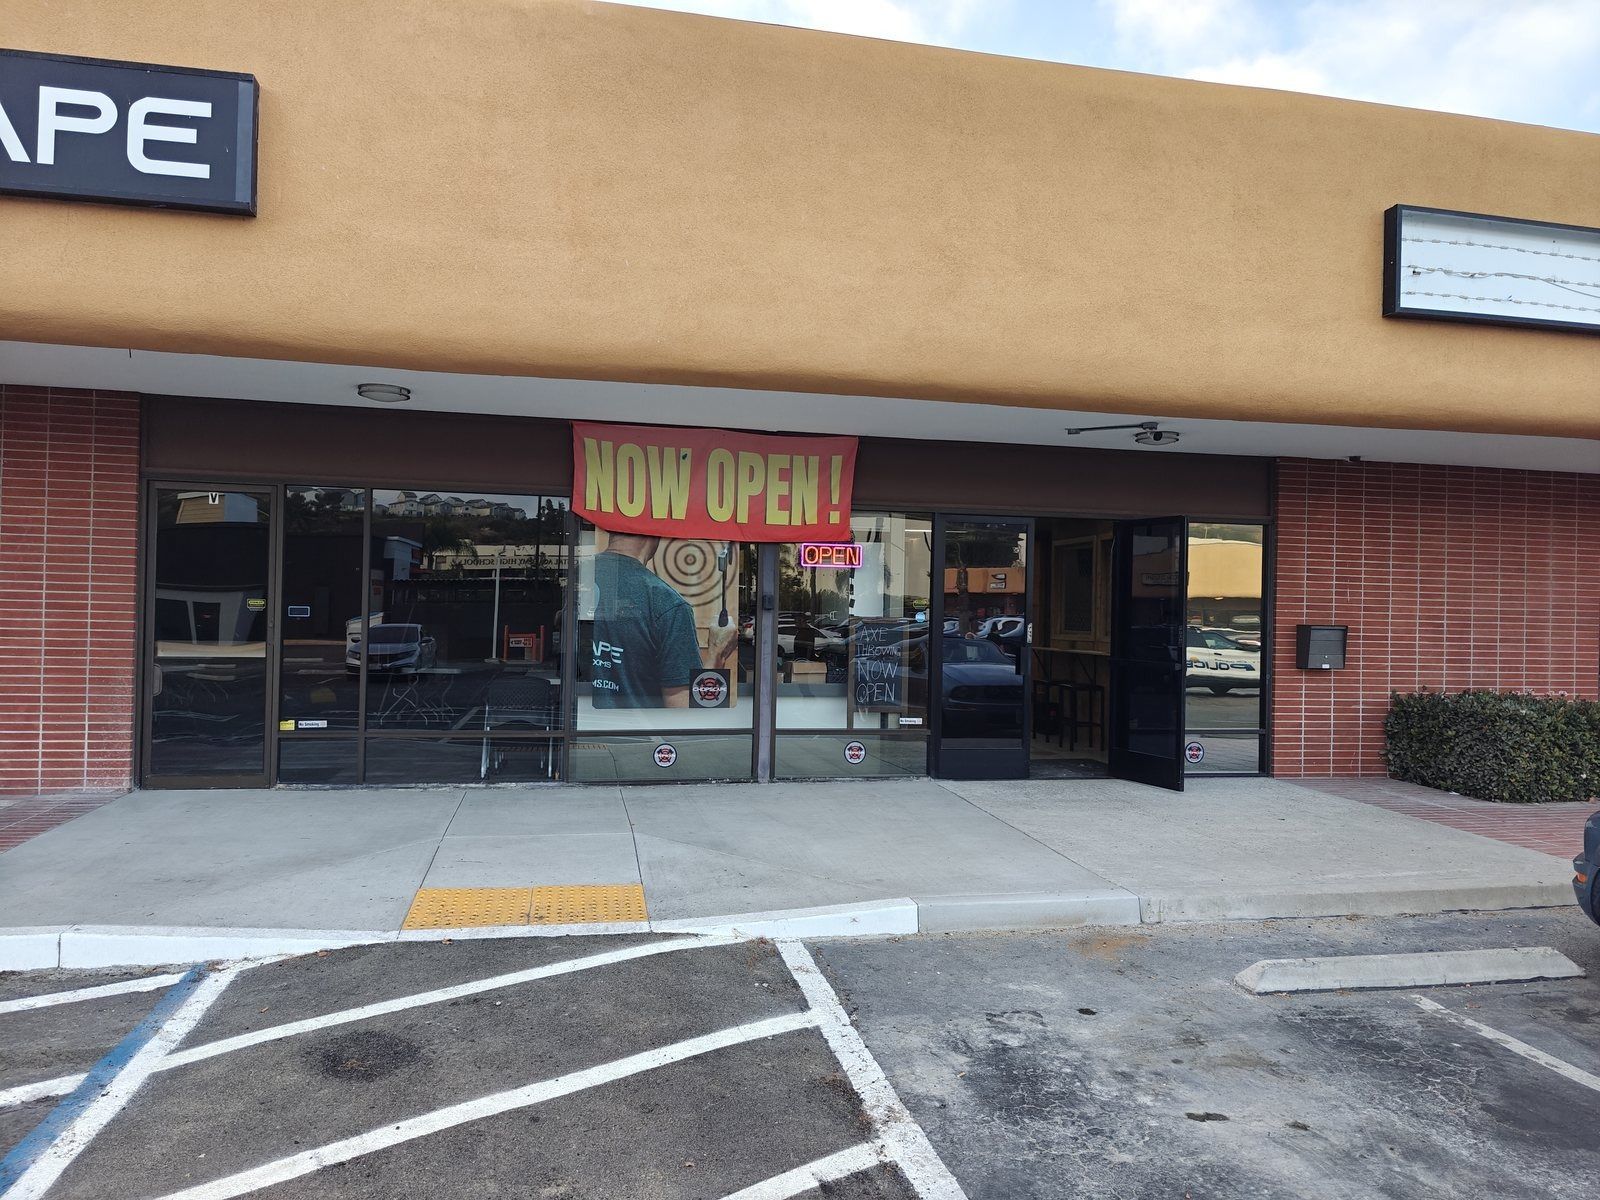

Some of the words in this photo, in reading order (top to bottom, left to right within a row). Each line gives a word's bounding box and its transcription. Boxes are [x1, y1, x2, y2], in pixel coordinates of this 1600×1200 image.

[583, 437, 692, 520] NOW
[805, 546, 859, 565] OPEN
[860, 626, 889, 642] AXE
[857, 660, 899, 681] NOW
[856, 682, 895, 703] OPEN
